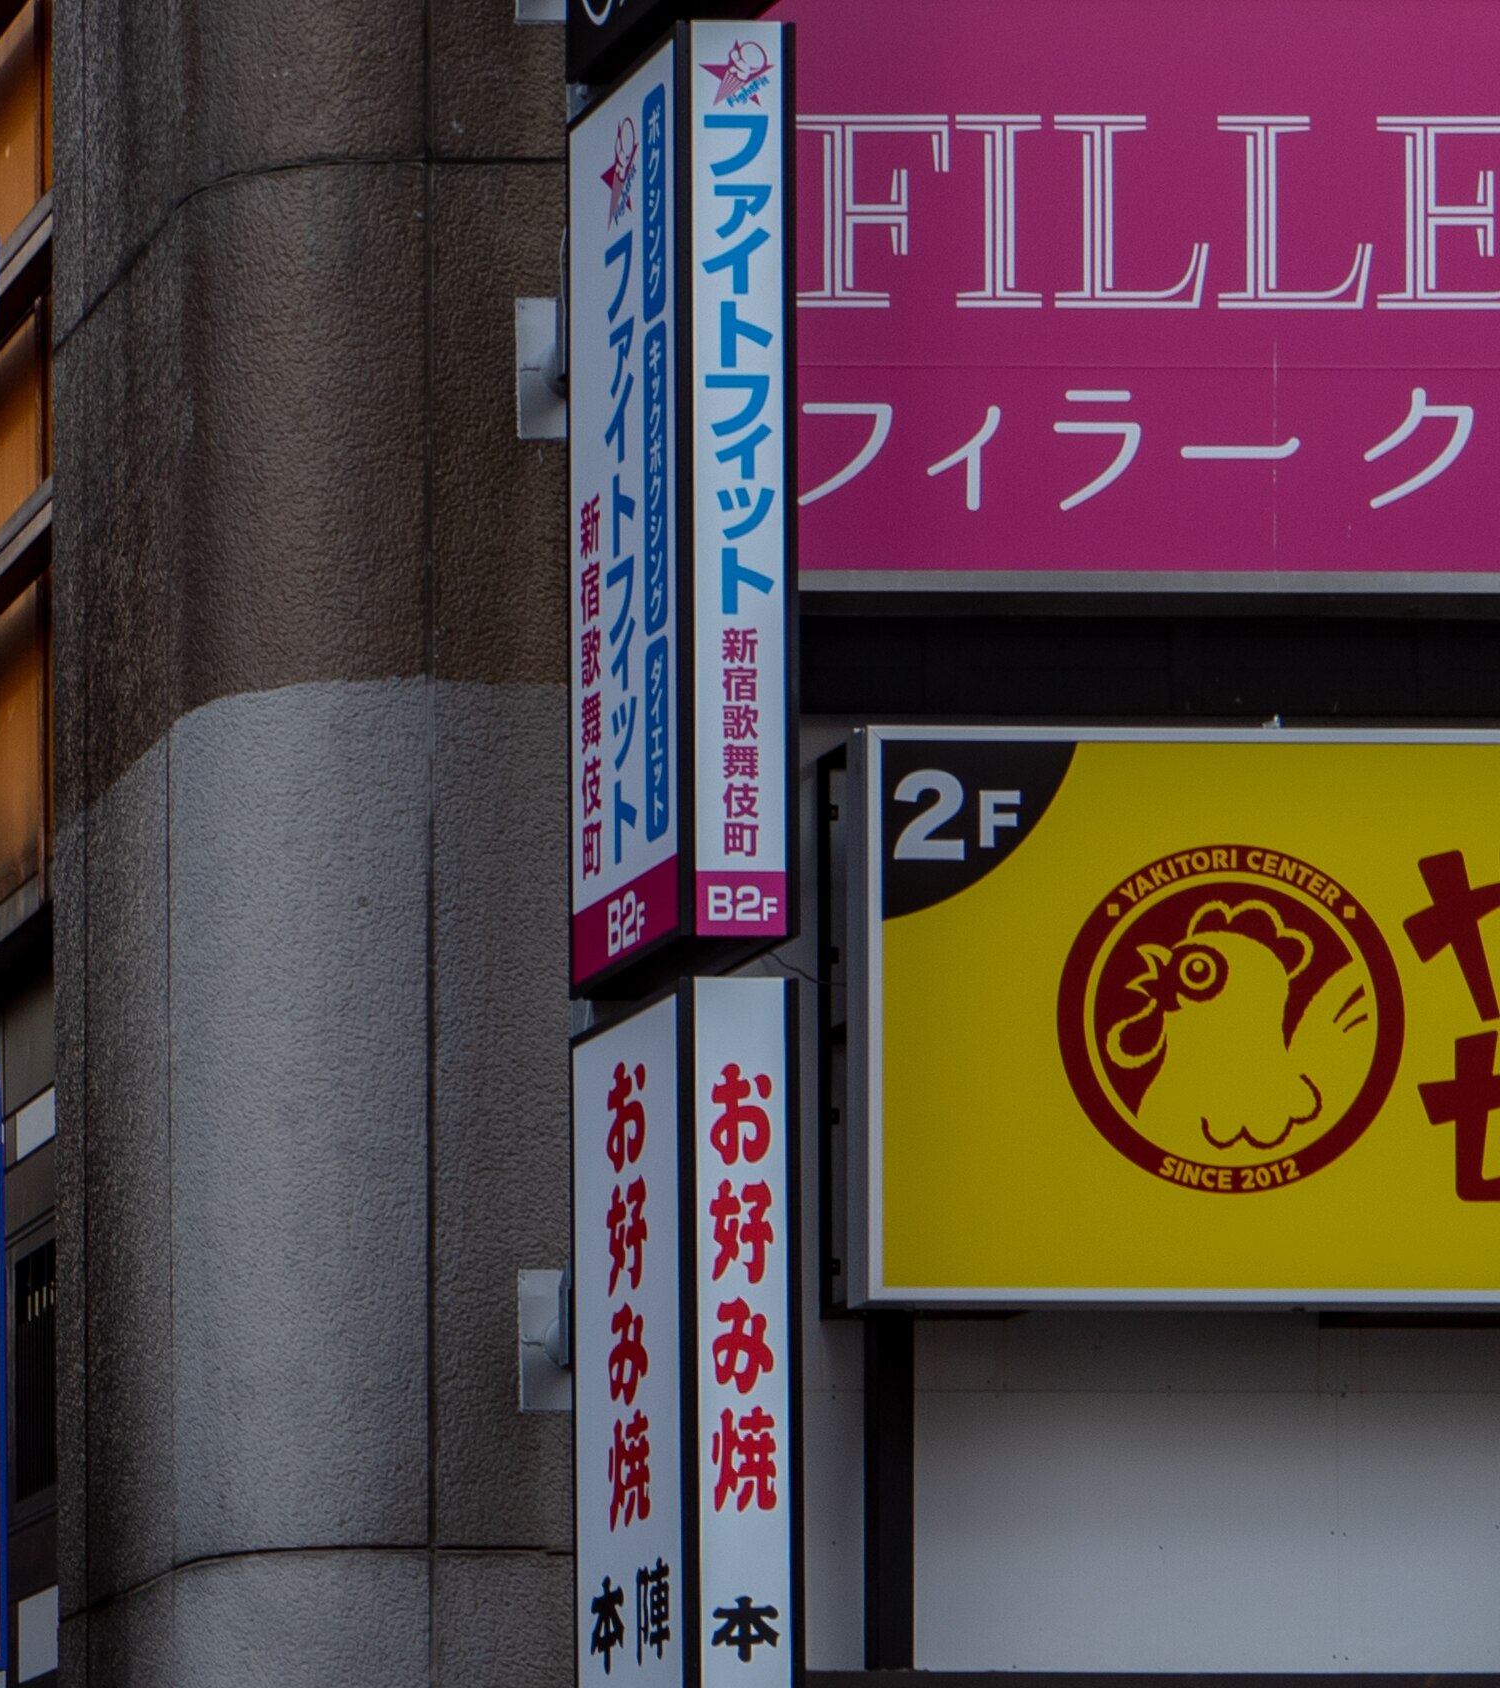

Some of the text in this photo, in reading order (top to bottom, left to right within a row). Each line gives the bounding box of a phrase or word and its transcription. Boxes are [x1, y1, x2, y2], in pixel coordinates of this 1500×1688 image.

[646, 107, 665, 300] ボクシング
[702, 113, 776, 616] ファイトフィット
[797, 387, 1474, 512] フィラーク
[603, 229, 637, 866] ファイトフィット
[645, 340, 665, 624] キックボクシング
[580, 493, 603, 878] 新宿歌舞伎町
[646, 654, 667, 820] ダイエット
[721, 628, 761, 857] 新宿歌舞伎町
[706, 883, 780, 922] B2F
[892, 768, 1021, 861] 2F
[1117, 846, 1342, 907] YAKITORI CENTER
[606, 899, 646, 963] B2F
[1159, 1155, 1300, 1191] SINCE 2012
[604, 1059, 652, 1534] お好み焼
[709, 1059, 778, 1515] お好み焼
[589, 1555, 673, 1675] 本陣
